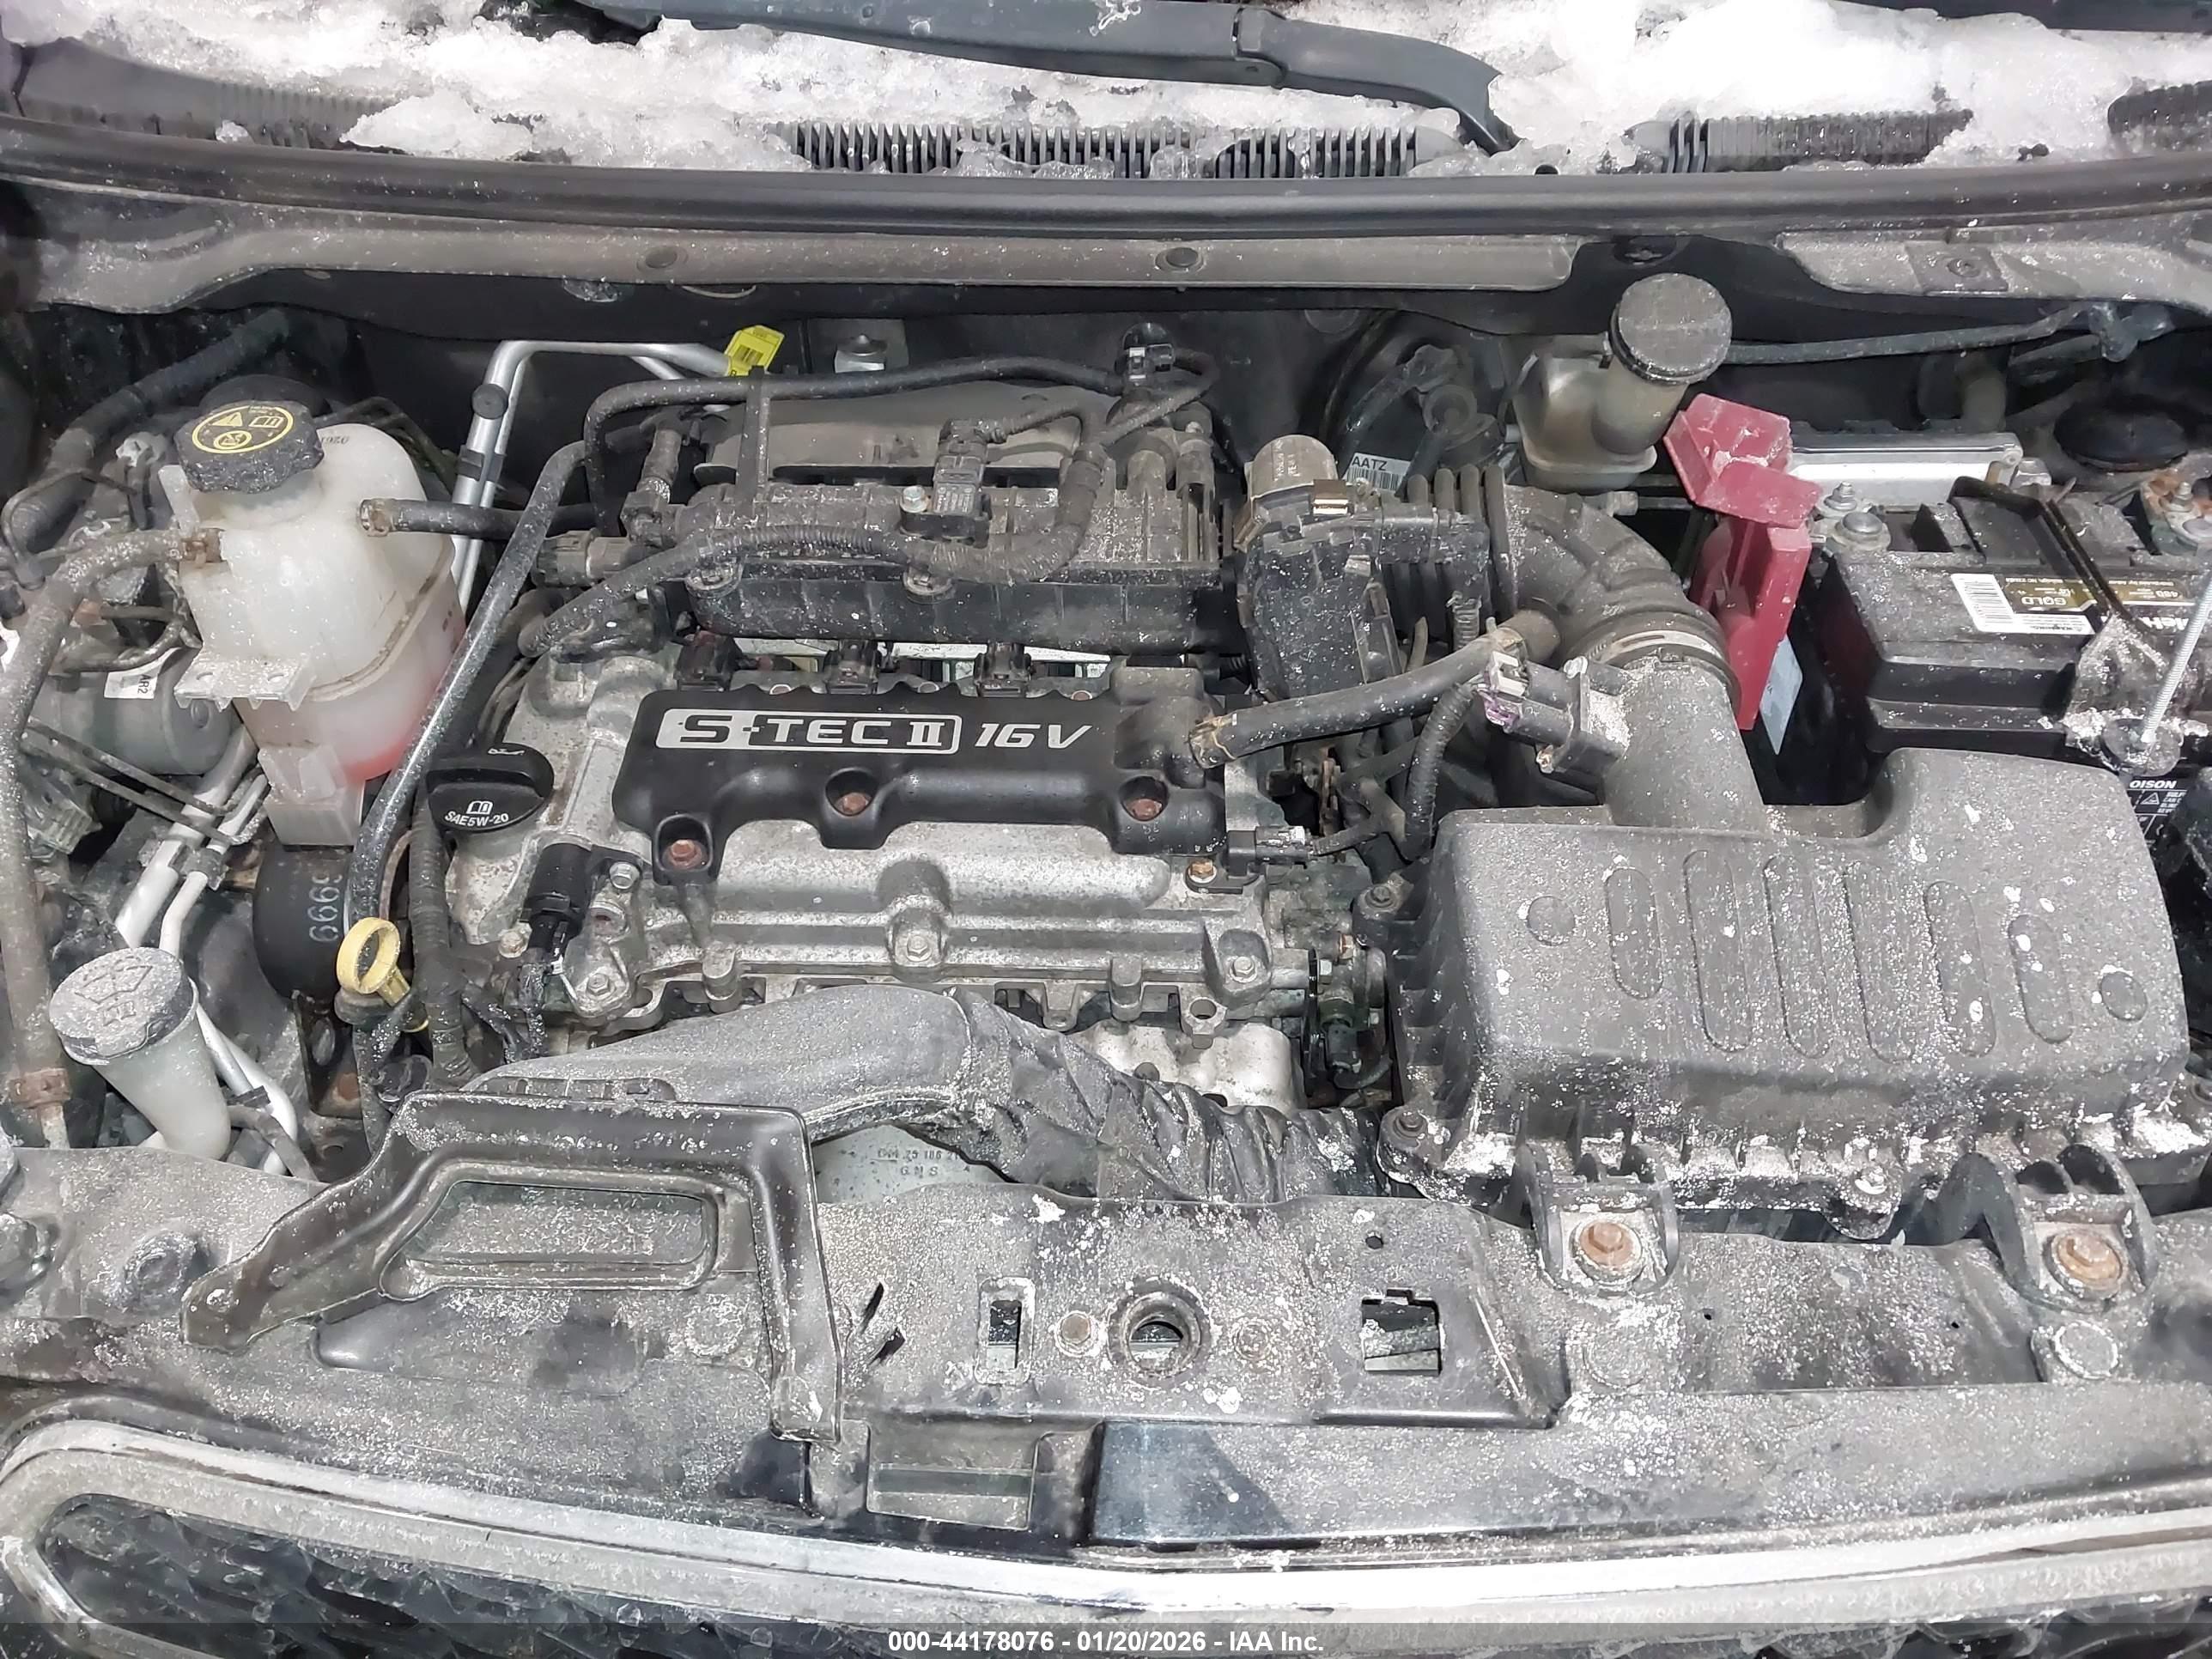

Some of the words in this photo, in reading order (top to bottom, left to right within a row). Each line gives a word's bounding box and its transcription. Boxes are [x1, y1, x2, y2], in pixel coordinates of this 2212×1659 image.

[1352, 456, 1388, 471] AATZ
[2021, 596, 2067, 605] GOLD
[137, 674, 151, 694] AR2
[975, 722, 1092, 749] 16V
[2129, 780, 2177, 789] OISON
